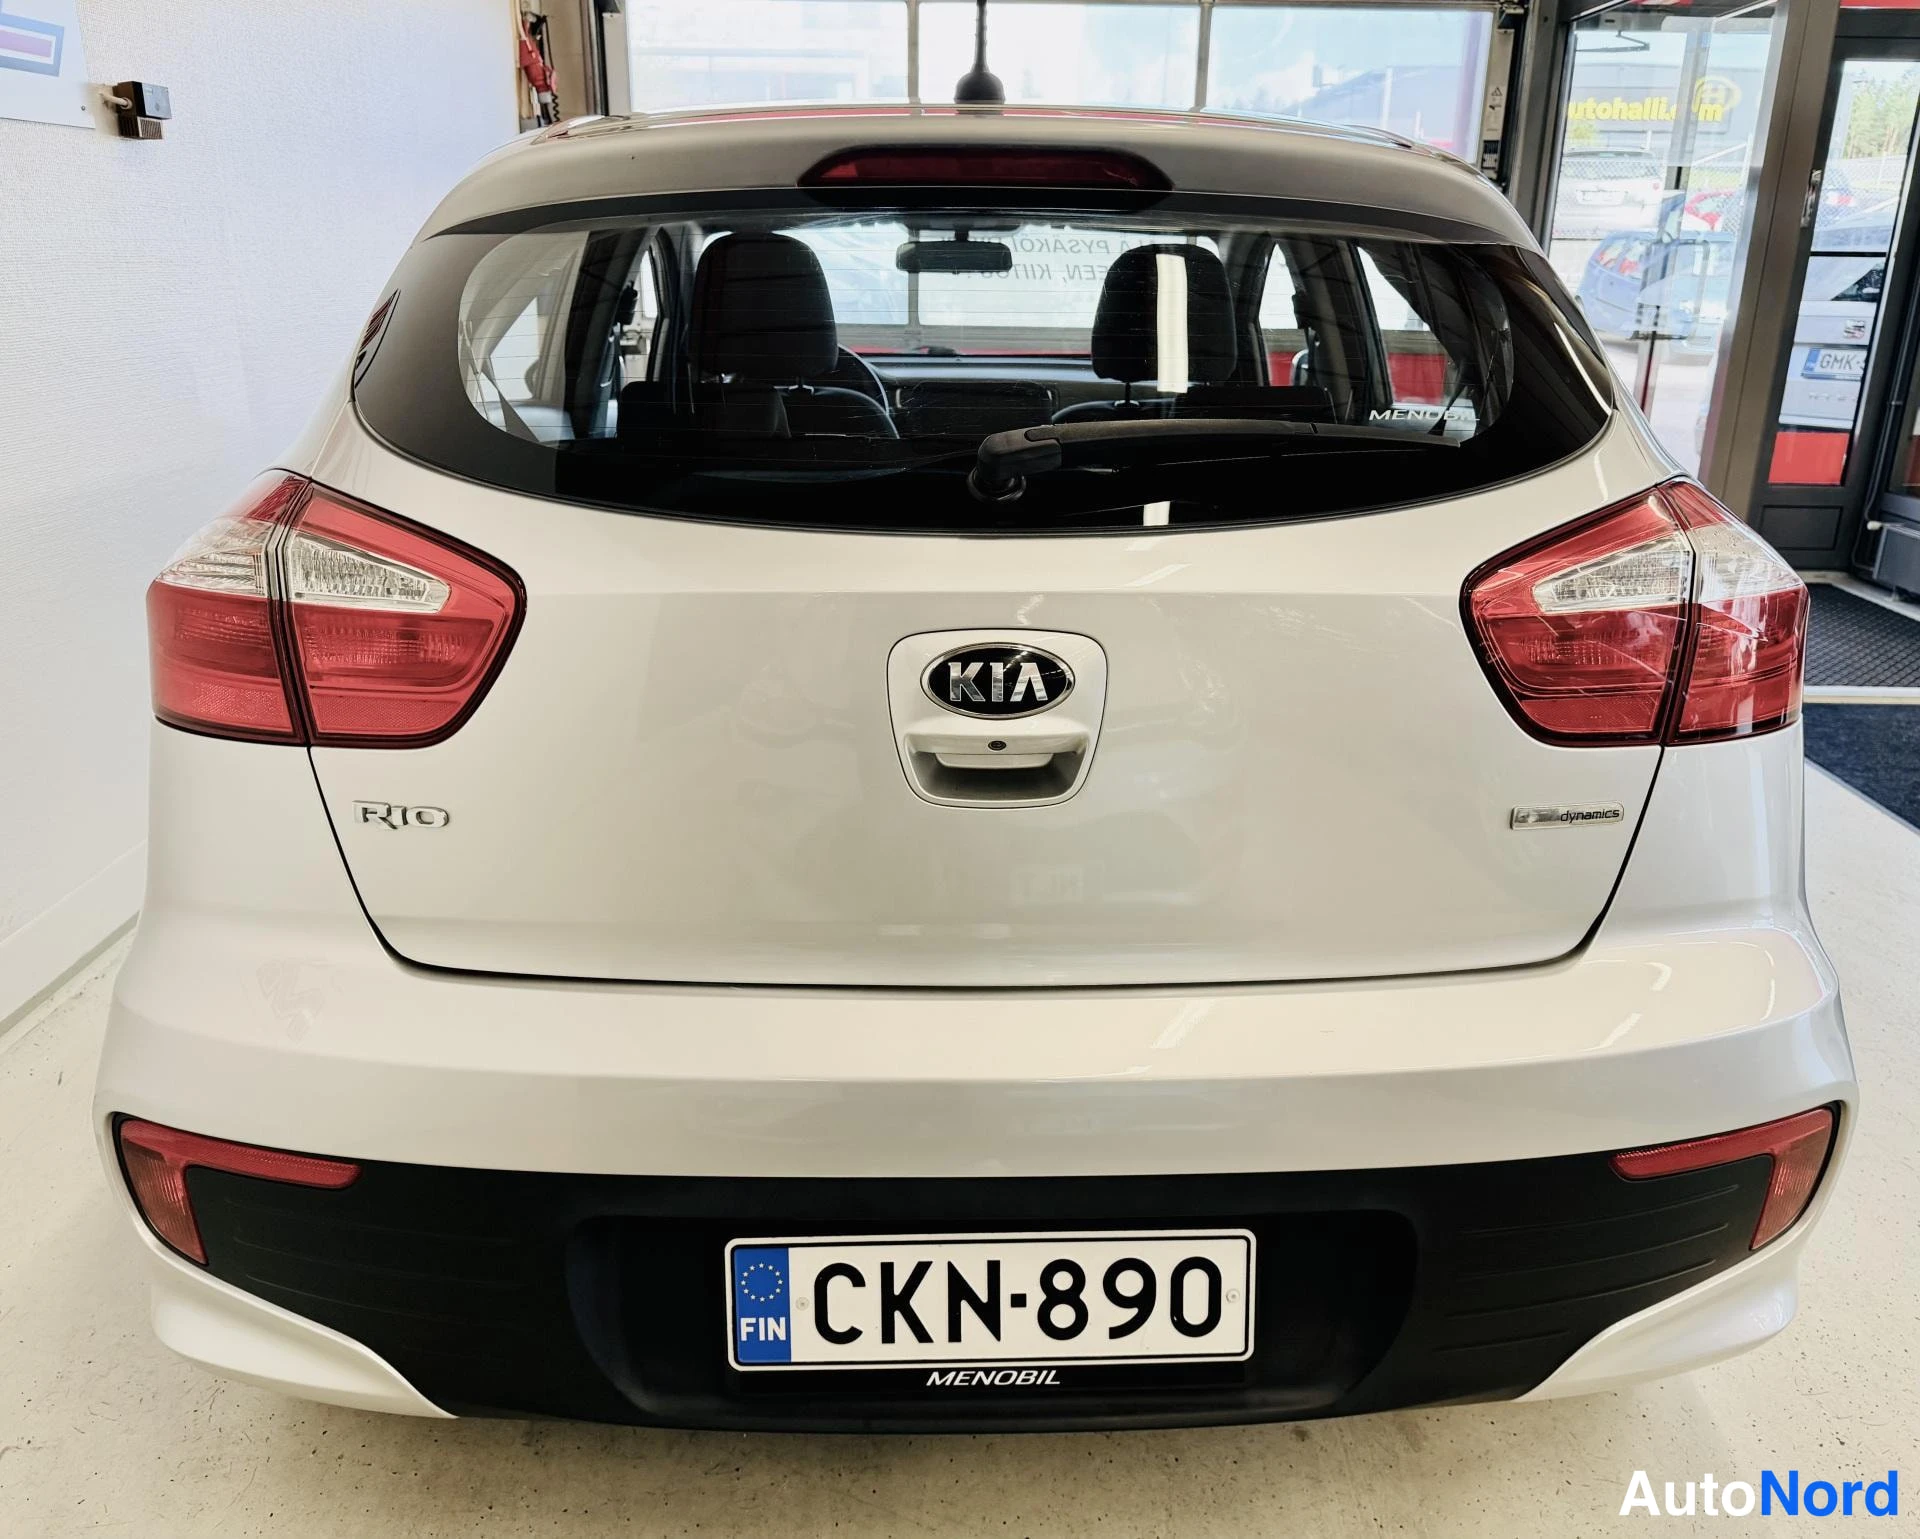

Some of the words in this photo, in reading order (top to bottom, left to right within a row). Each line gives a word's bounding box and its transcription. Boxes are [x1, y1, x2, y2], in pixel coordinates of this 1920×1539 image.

[948, 661, 1049, 702] KIA
[353, 800, 450, 830] RIO
[1560, 808, 1620, 824] dynamics
[813, 1255, 1223, 1345] CKN-890
[739, 1316, 788, 1341] FIN
[926, 1369, 1061, 1387] MENOBIL
